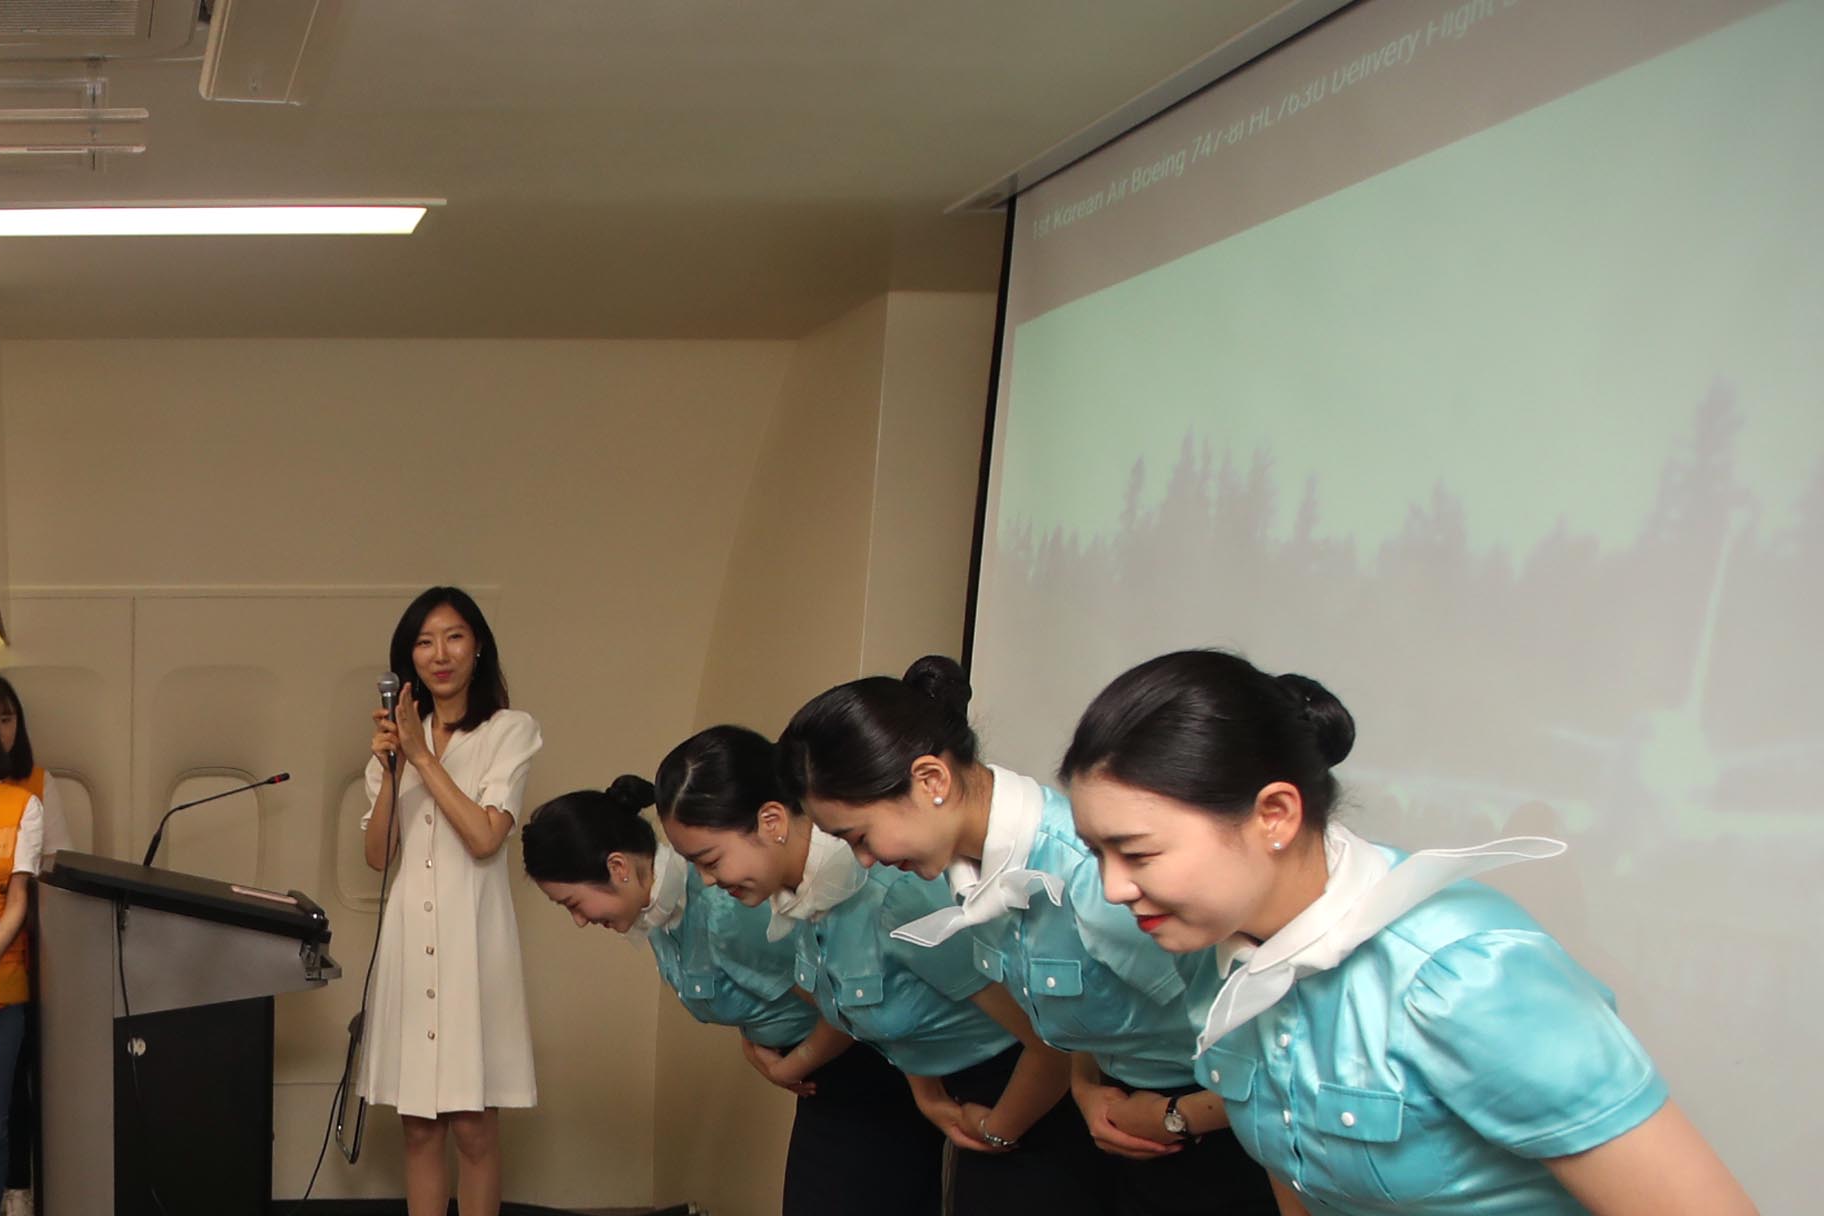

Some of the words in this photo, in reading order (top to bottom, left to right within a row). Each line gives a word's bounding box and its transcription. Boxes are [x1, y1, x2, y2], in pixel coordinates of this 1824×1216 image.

[1053, 190, 1106, 231] Korean
[1107, 179, 1129, 206] Air
[1130, 149, 1188, 194] Boeing
[1331, 27, 1421, 95] Delivery
